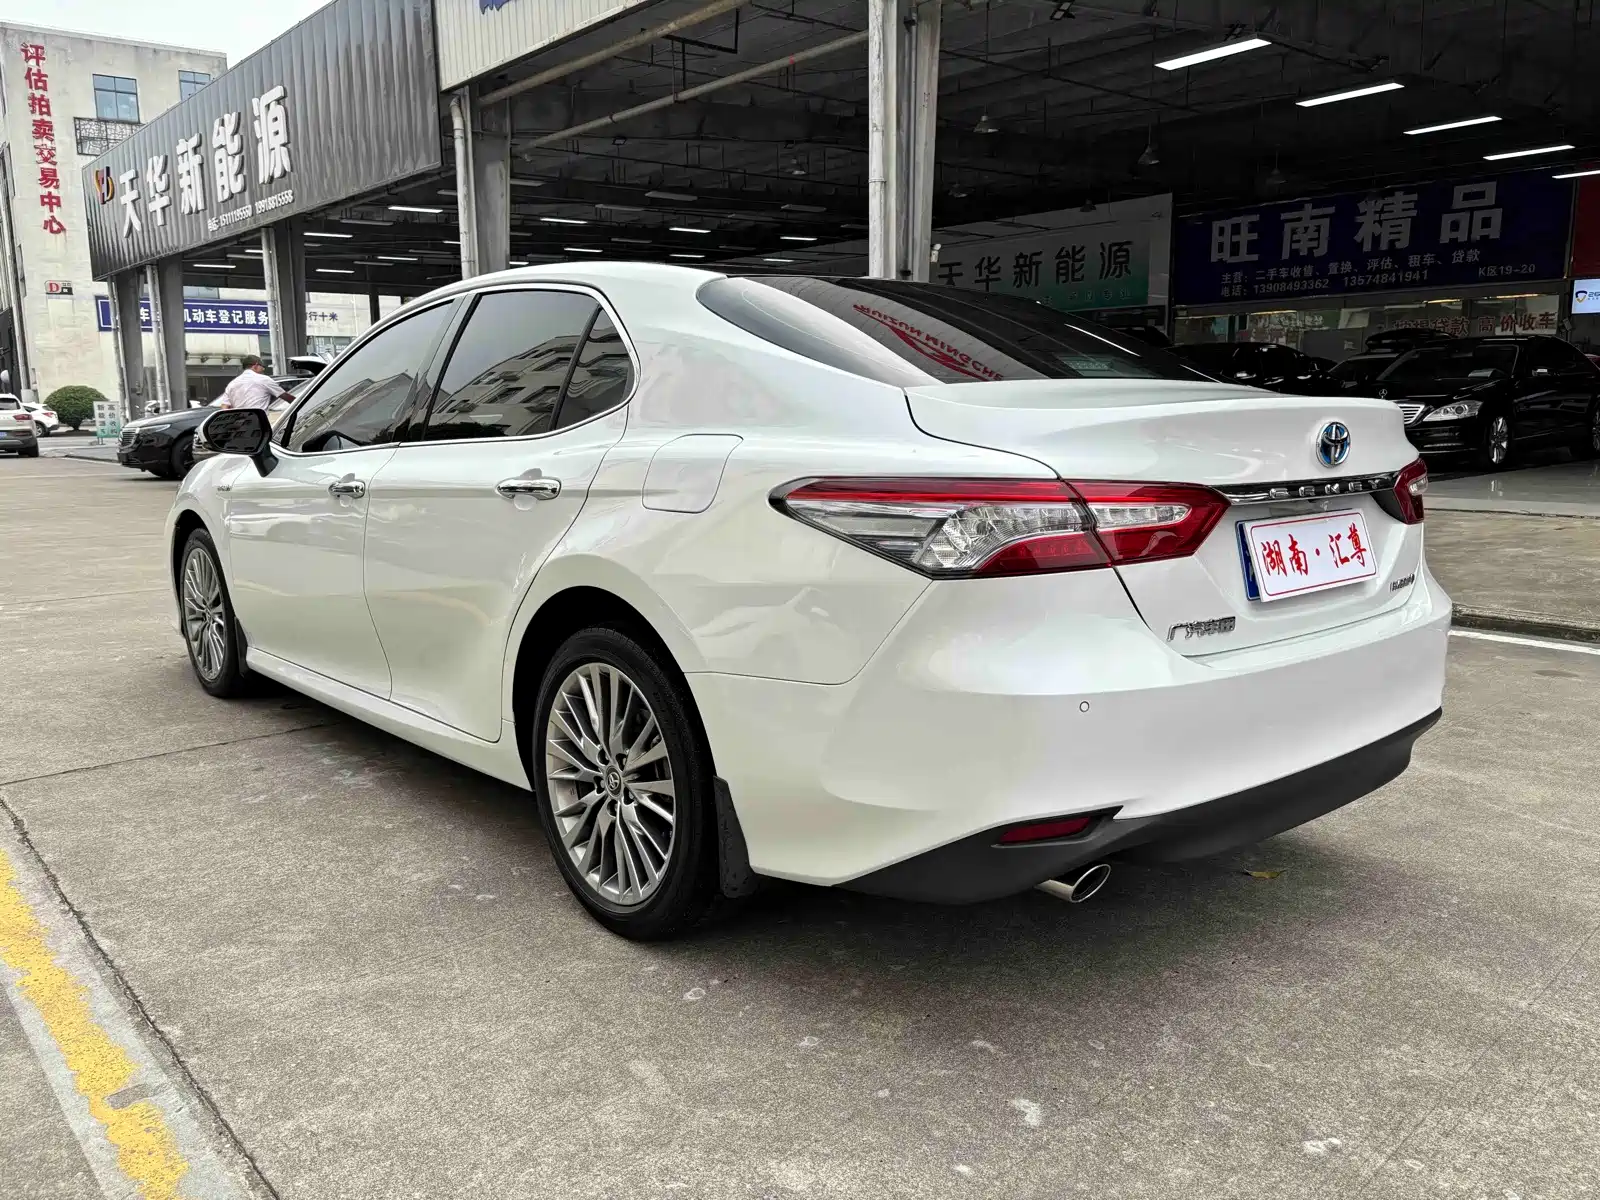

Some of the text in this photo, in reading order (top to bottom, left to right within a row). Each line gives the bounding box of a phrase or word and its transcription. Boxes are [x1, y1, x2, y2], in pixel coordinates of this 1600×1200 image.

[21, 43, 66, 235] 评估拍卖交易中心
[120, 86, 292, 239] 天华新能源
[1211, 181, 1503, 263] 旺南精品
[938, 240, 1133, 292] 天华新能源
[305, 311, 338, 322] 行十米
[1478, 312, 1556, 333] 高价收车
